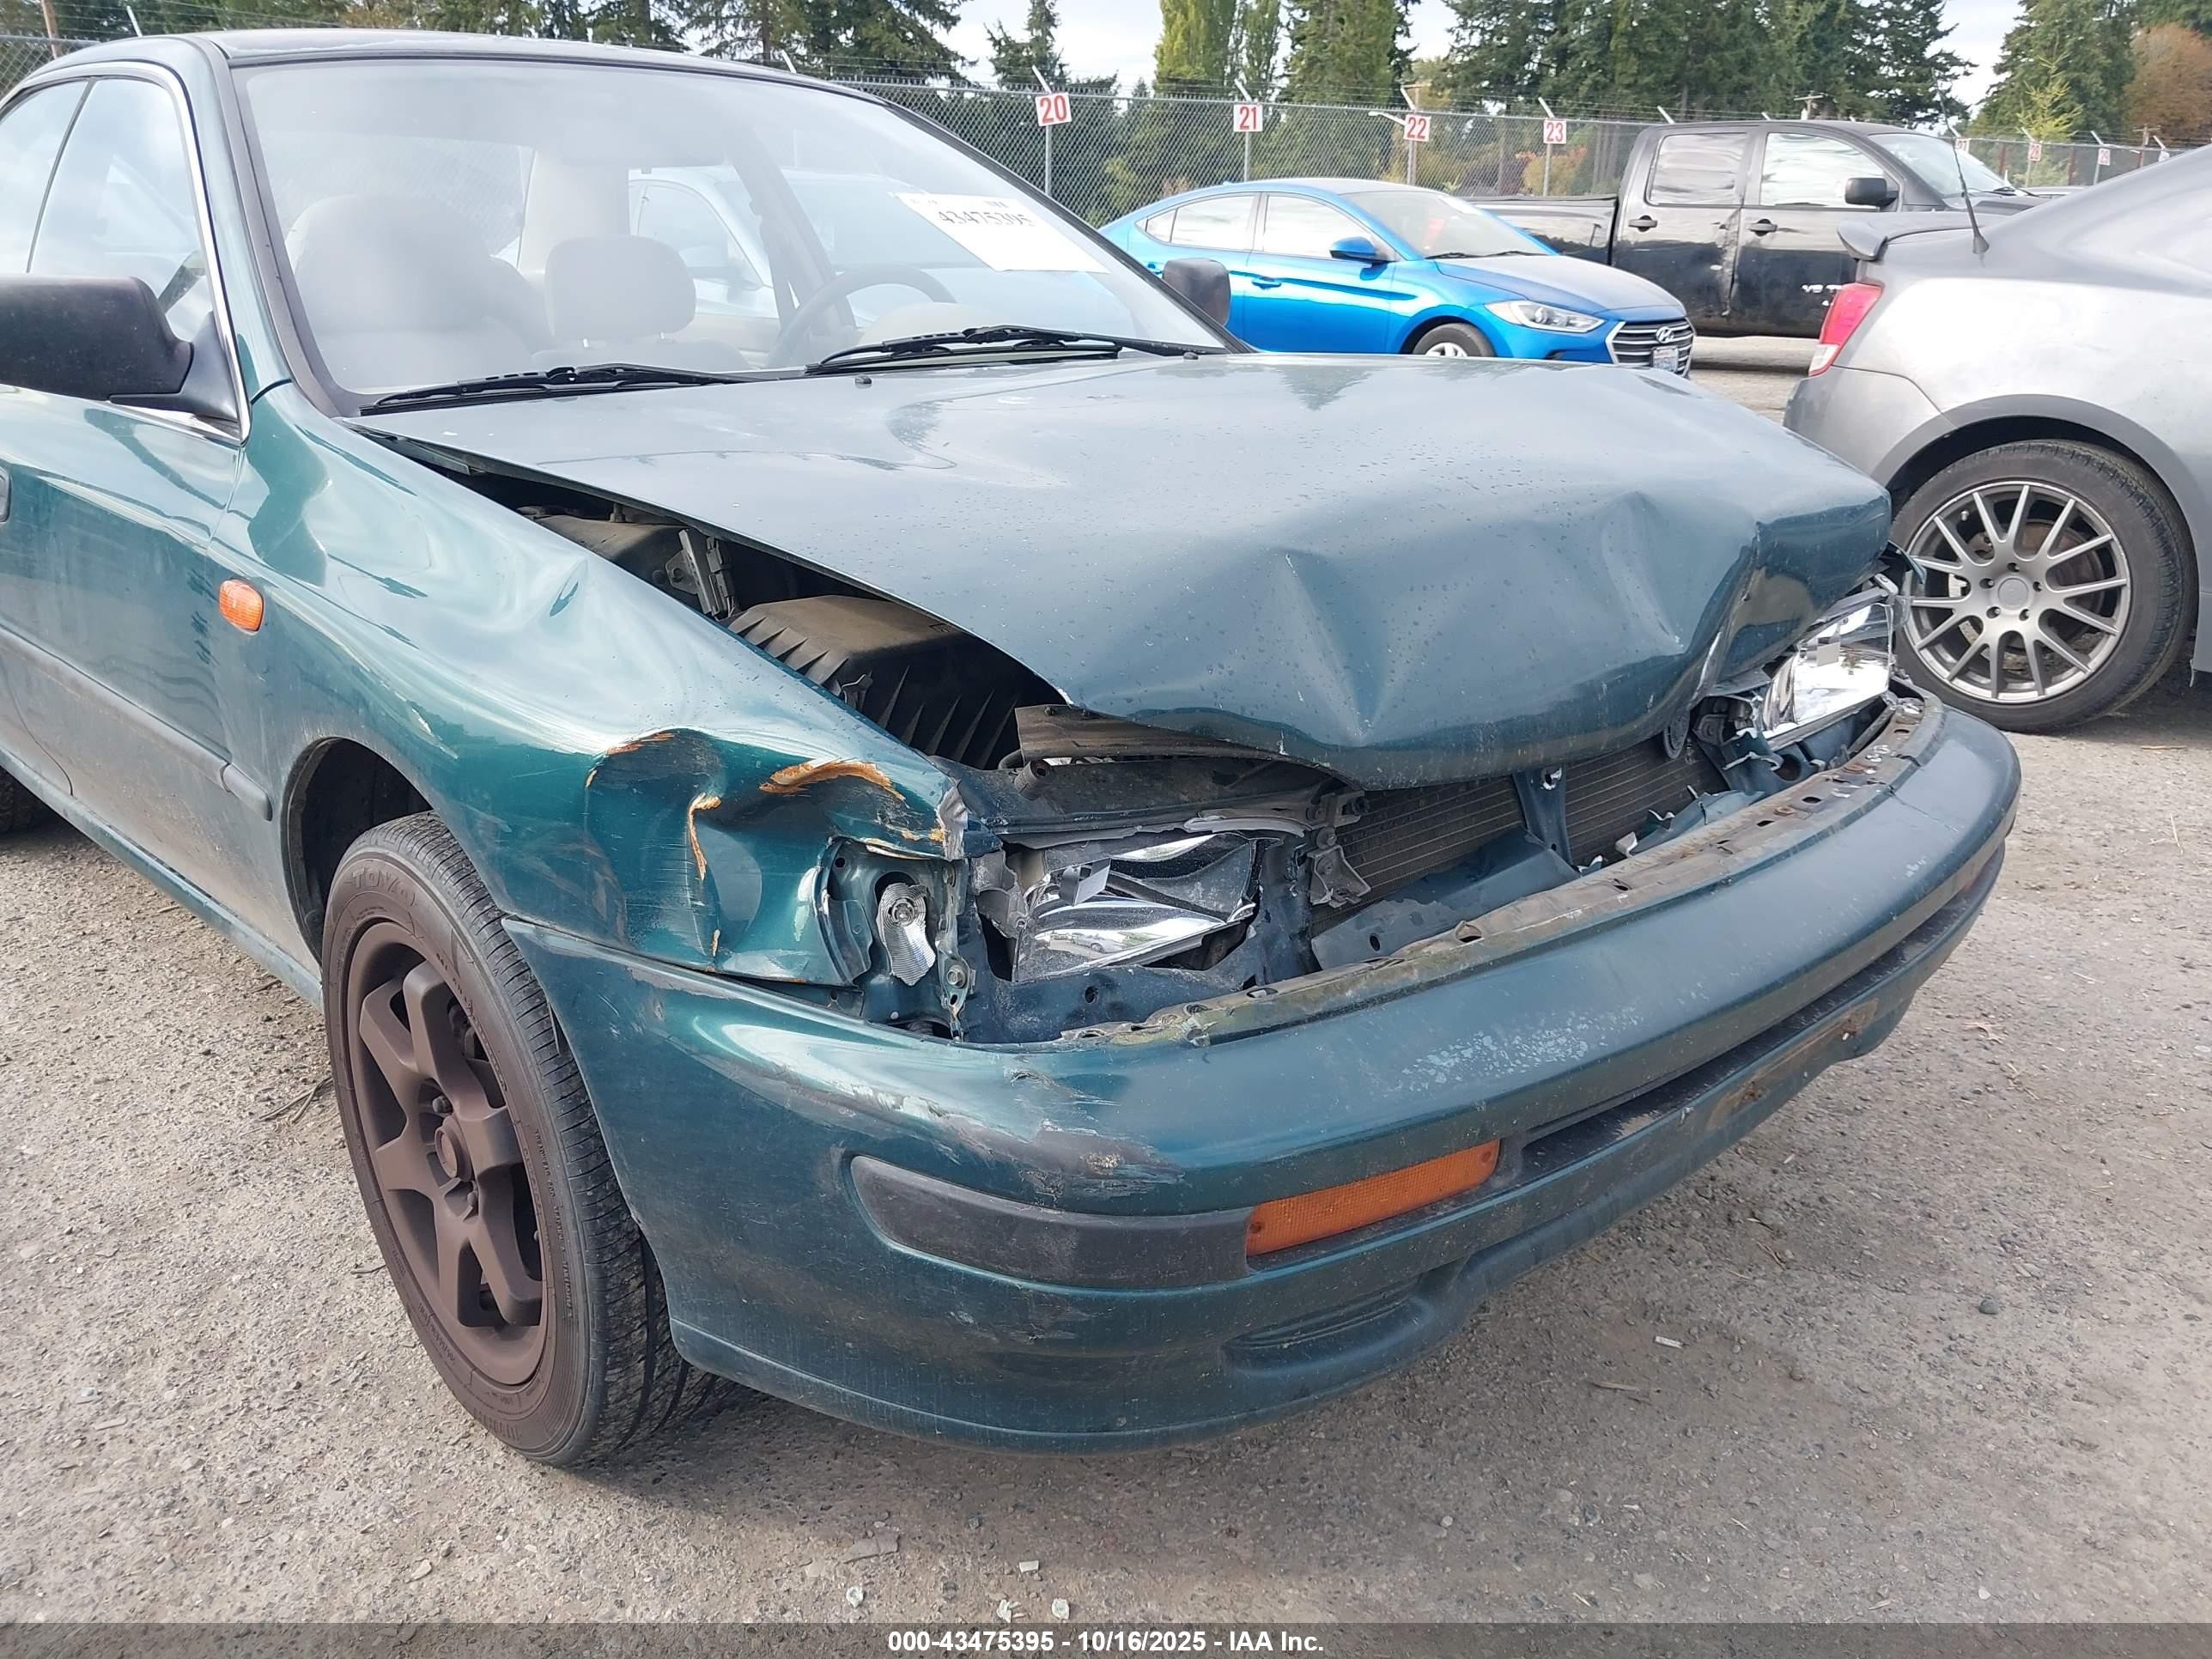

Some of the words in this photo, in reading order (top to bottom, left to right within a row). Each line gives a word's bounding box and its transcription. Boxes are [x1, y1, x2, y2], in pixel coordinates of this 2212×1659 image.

[1040, 95, 1066, 124] 20
[1240, 106, 1256, 130] 21
[1407, 117, 1426, 139] 22
[1547, 122, 1563, 142] 23
